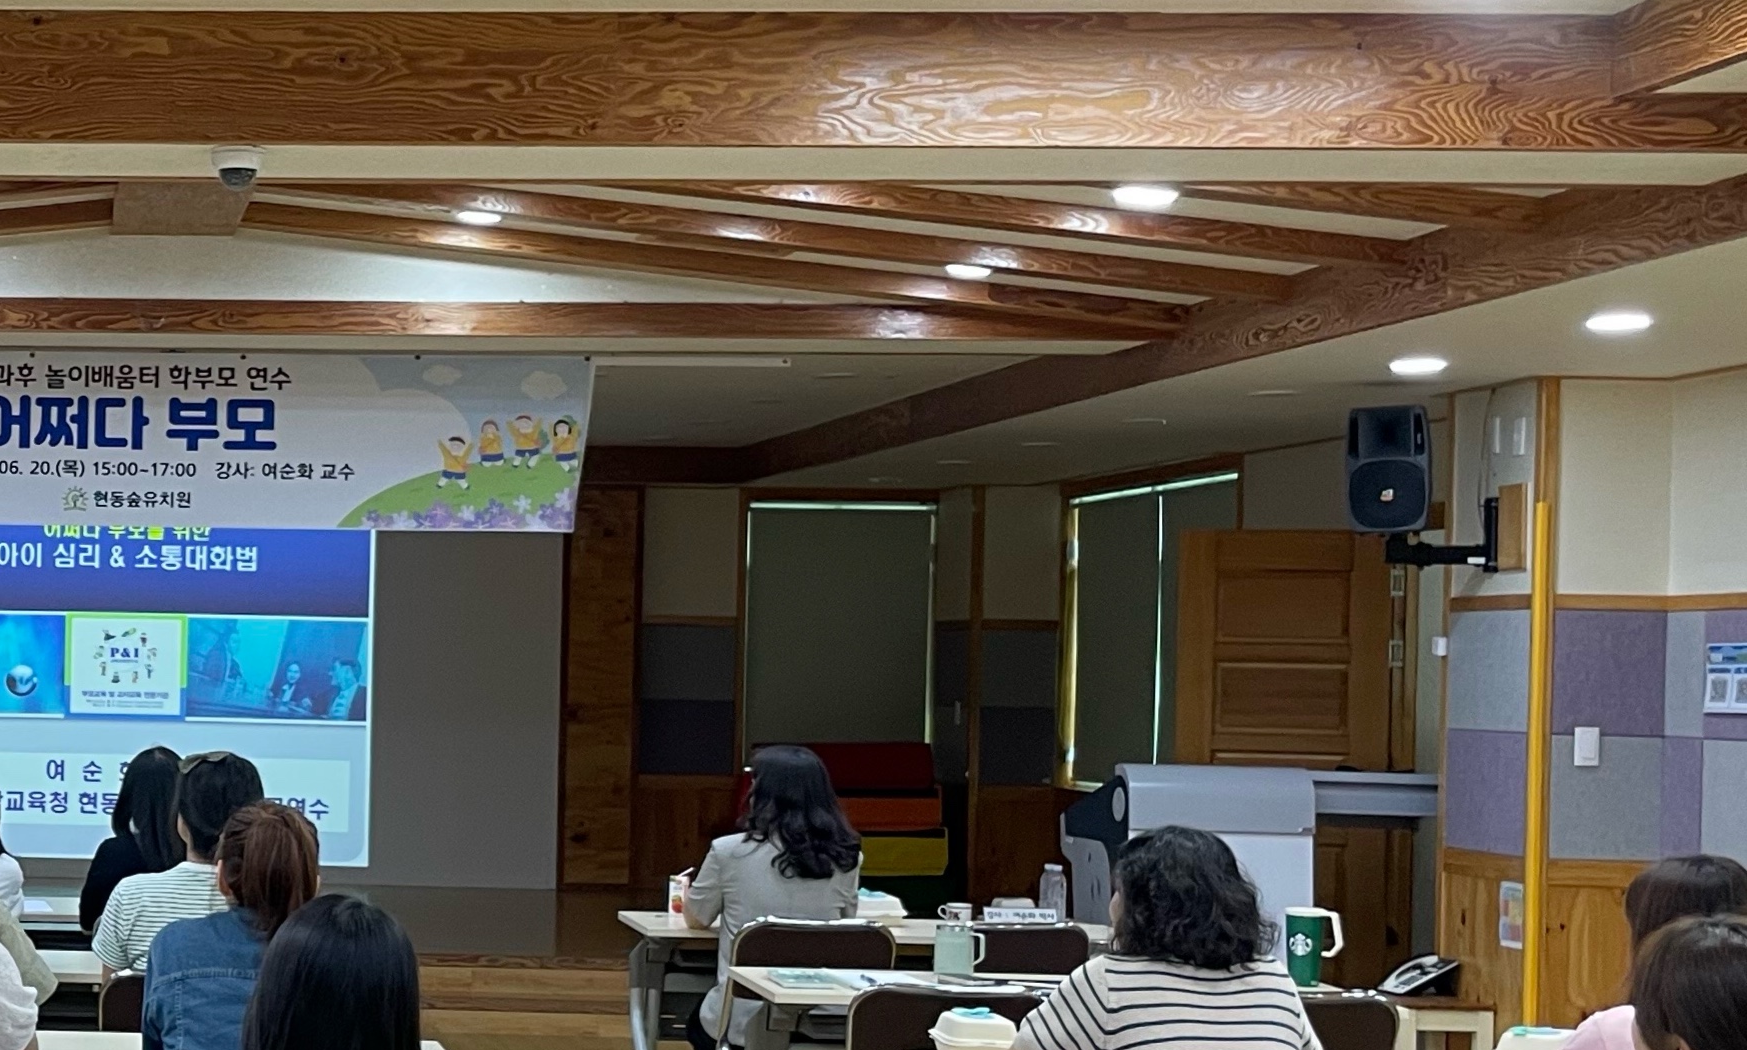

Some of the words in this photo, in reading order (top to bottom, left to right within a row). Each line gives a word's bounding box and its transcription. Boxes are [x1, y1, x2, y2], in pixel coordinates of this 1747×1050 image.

[45, 364, 160, 390] 놀이배움터
[169, 366, 238, 390] 학부모
[246, 366, 292, 391] 연수
[165, 397, 277, 451] 부모
[93, 461, 197, 477] 15:00~17:00
[215, 462, 255, 480] 강사:
[261, 462, 314, 480] 여순화
[319, 463, 355, 481] 교수
[92, 490, 192, 508] 현동숲유치원
[53, 543, 101, 569] 심리
[109, 545, 126, 568] &
[134, 544, 258, 572] 소통대화법
